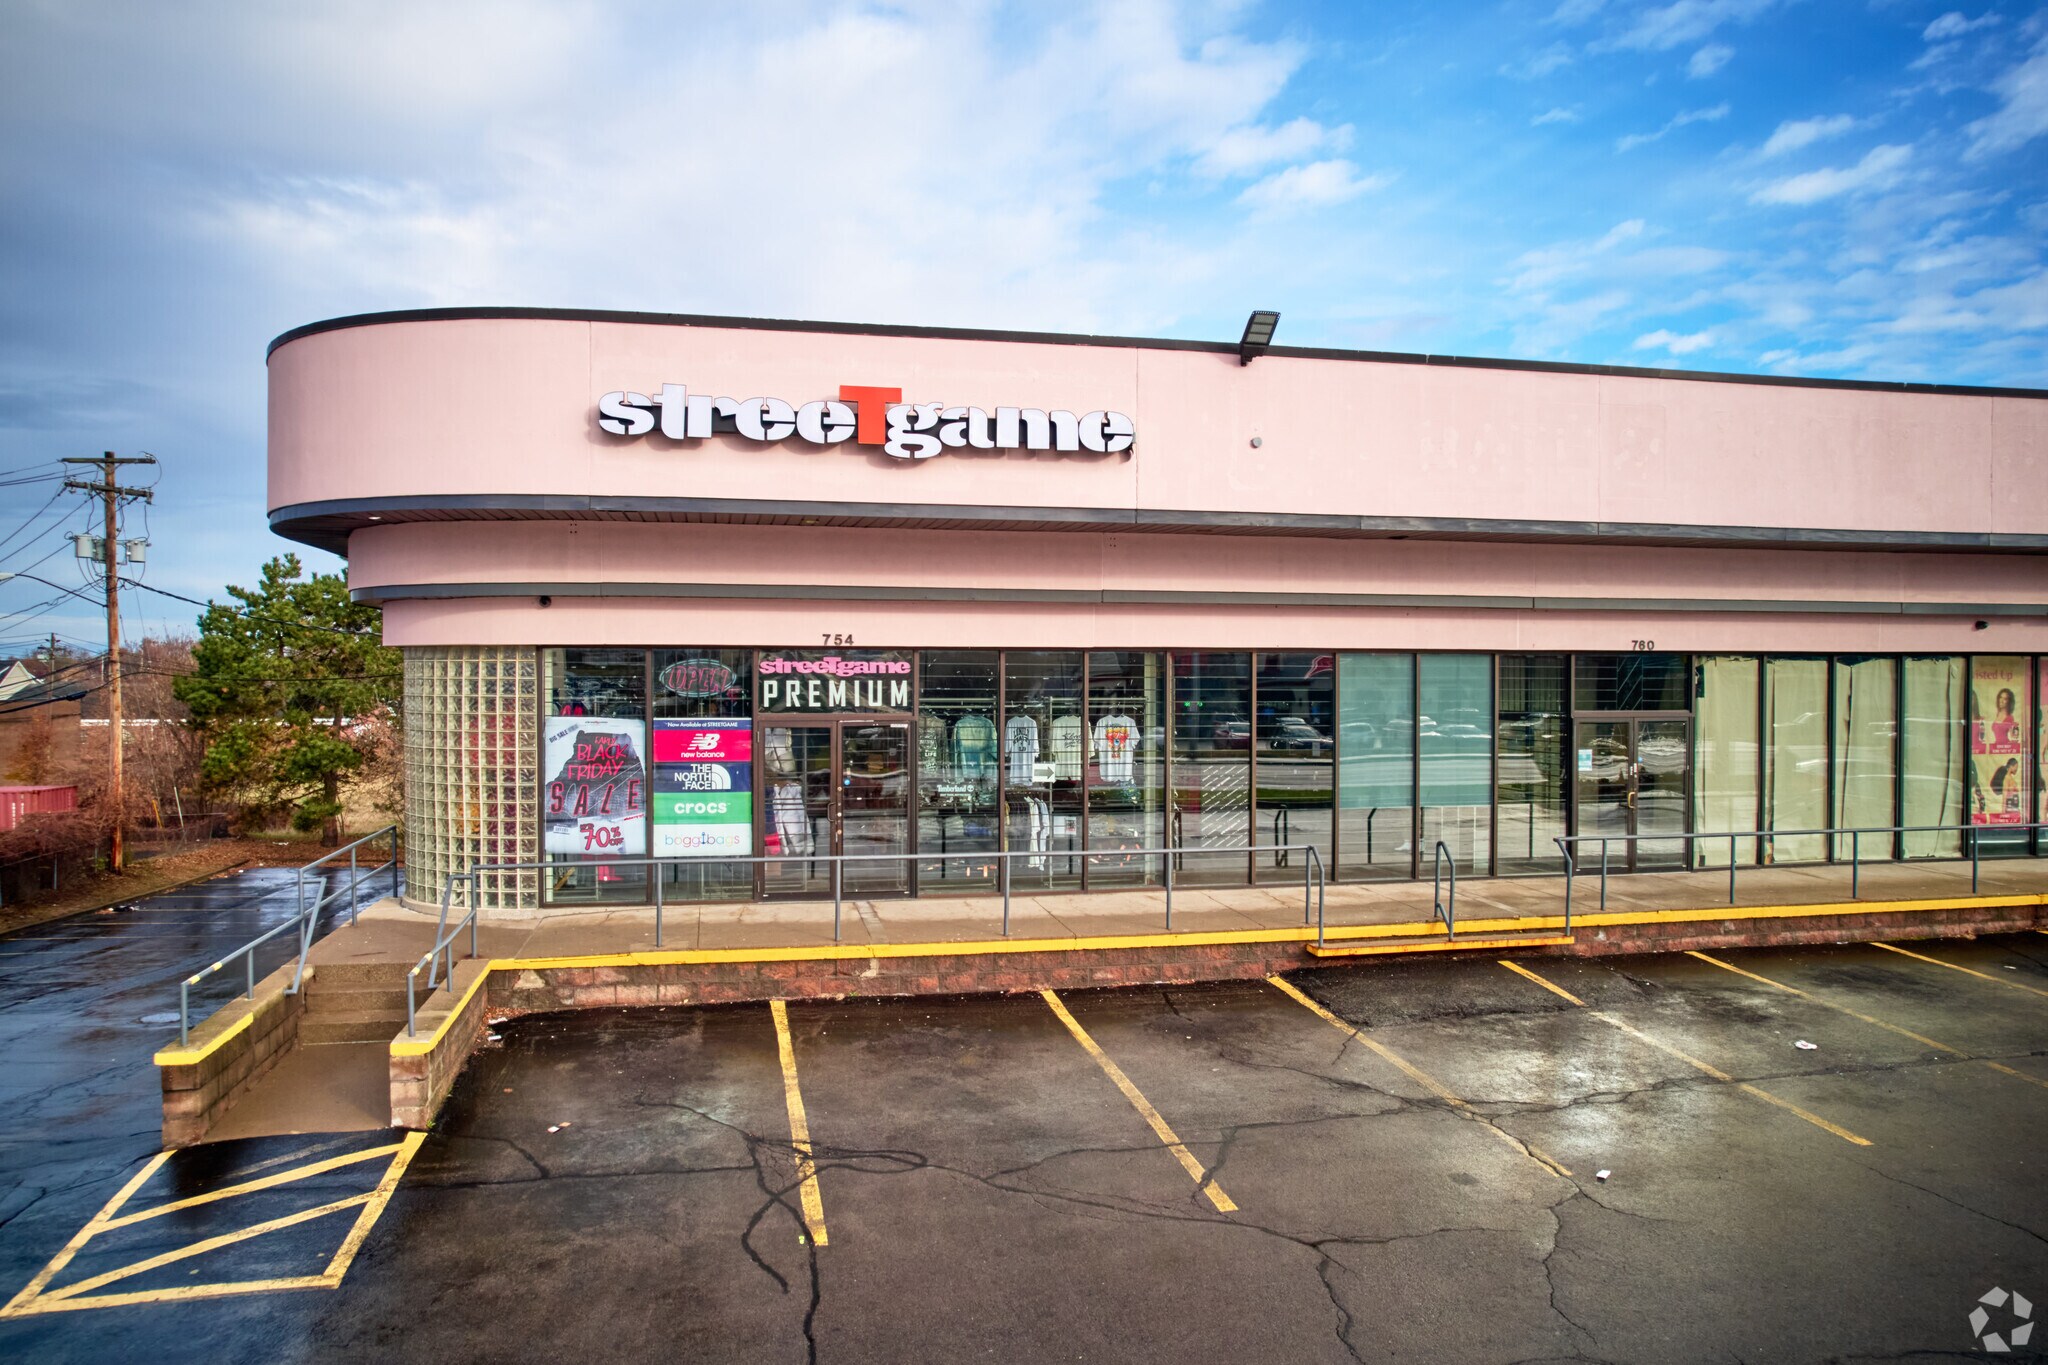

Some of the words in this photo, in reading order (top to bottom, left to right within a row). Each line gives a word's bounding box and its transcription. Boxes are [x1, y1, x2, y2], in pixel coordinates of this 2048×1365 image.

[822, 634, 854, 646] 754
[1631, 639, 1655, 651] 760
[668, 665, 729, 692] OPEN
[763, 679, 908, 708] PREMIUM
[577, 743, 629, 761] BLACK
[568, 759, 624, 781] FRIDAY
[690, 763, 711, 773] THE
[674, 772, 711, 782] NORTH
[684, 781, 711, 790] FACE
[550, 778, 641, 816] SALE
[674, 802, 727, 814] crocs
